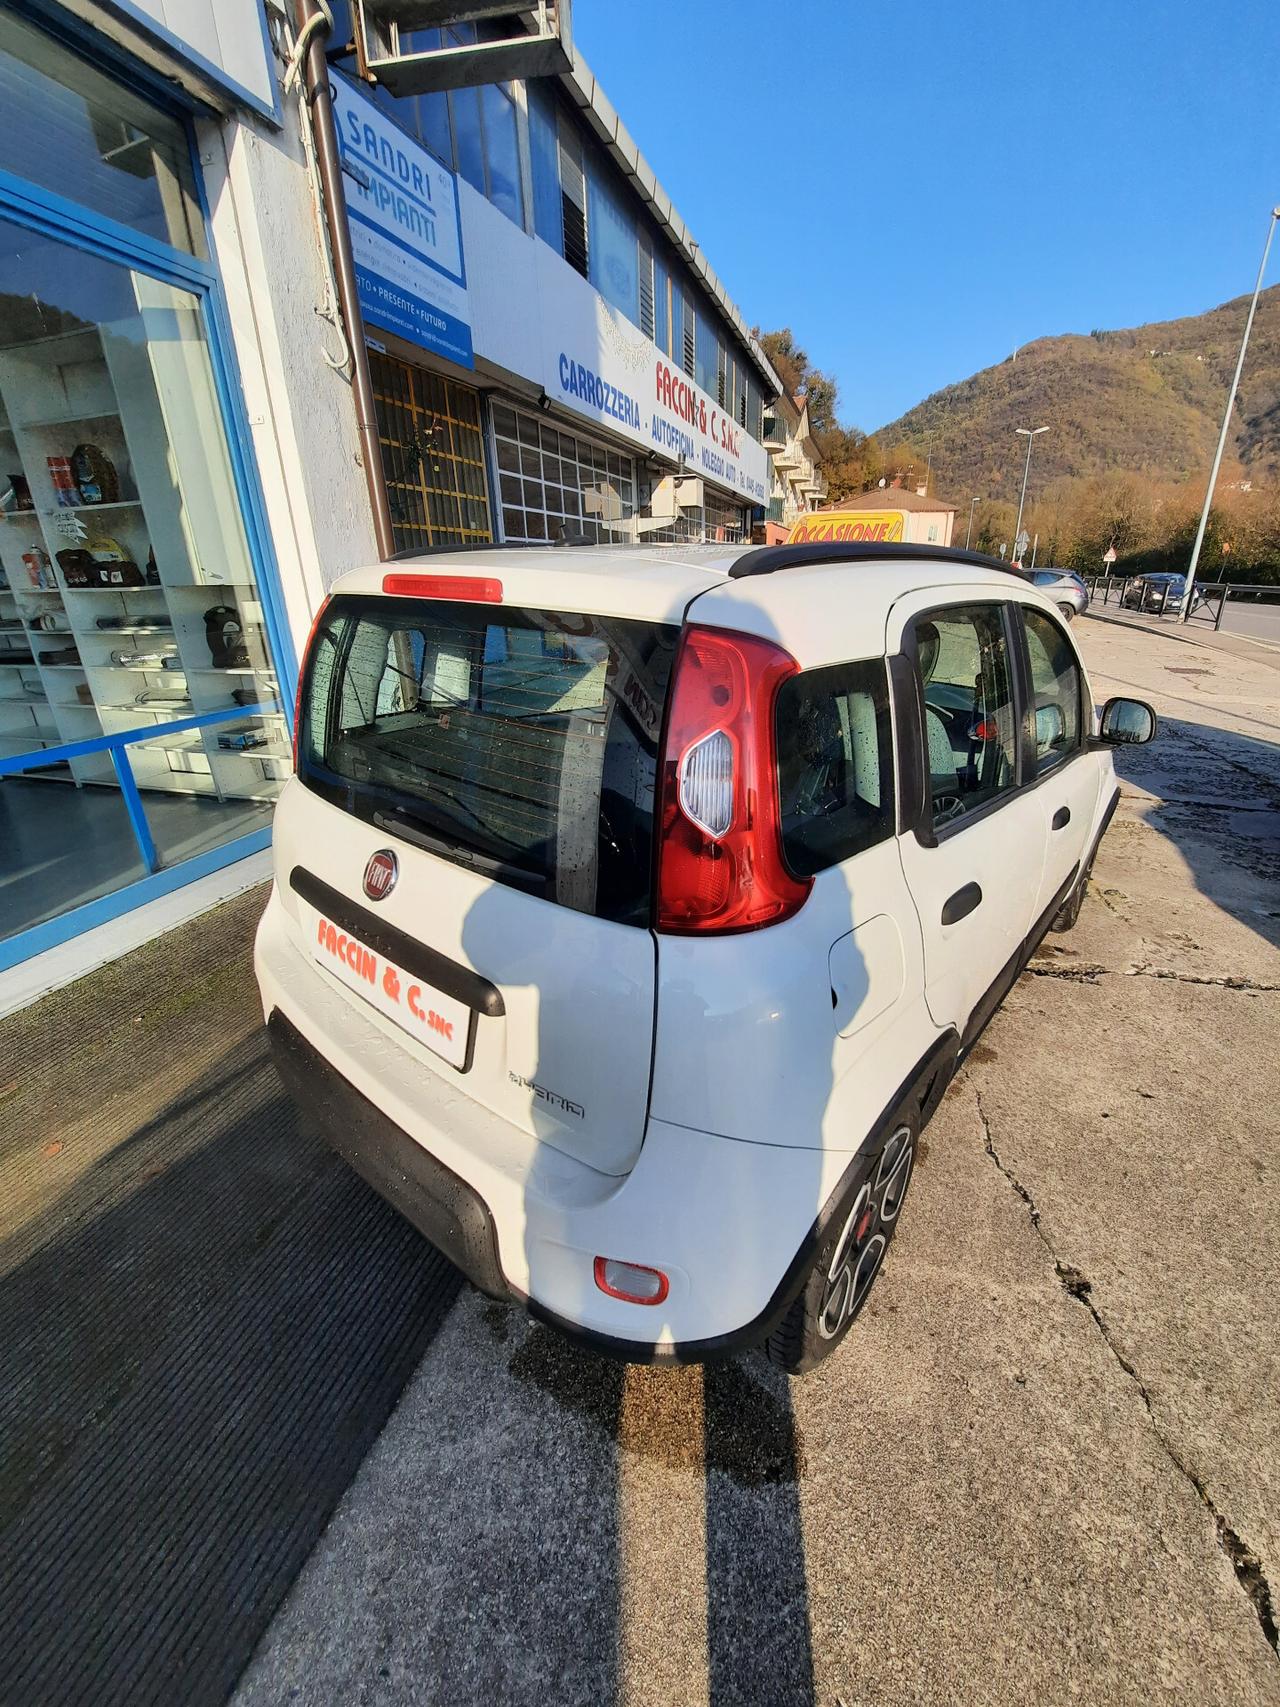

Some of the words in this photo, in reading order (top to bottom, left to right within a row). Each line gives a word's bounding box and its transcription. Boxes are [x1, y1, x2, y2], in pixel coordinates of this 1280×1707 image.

[347, 110, 431, 201] SANDRI
[378, 286, 415, 315] PRESENTE
[420, 309, 447, 332] FUTURO
[559, 352, 641, 431] CARROZZERIA
[651, 414, 695, 461] AUTOFFICINA
[656, 361, 695, 427] FACCIN
[699, 399, 707, 436] &
[367, 861, 391, 890] FIAT
[318, 919, 376, 984] FACCIN
[382, 966, 401, 1004] &
